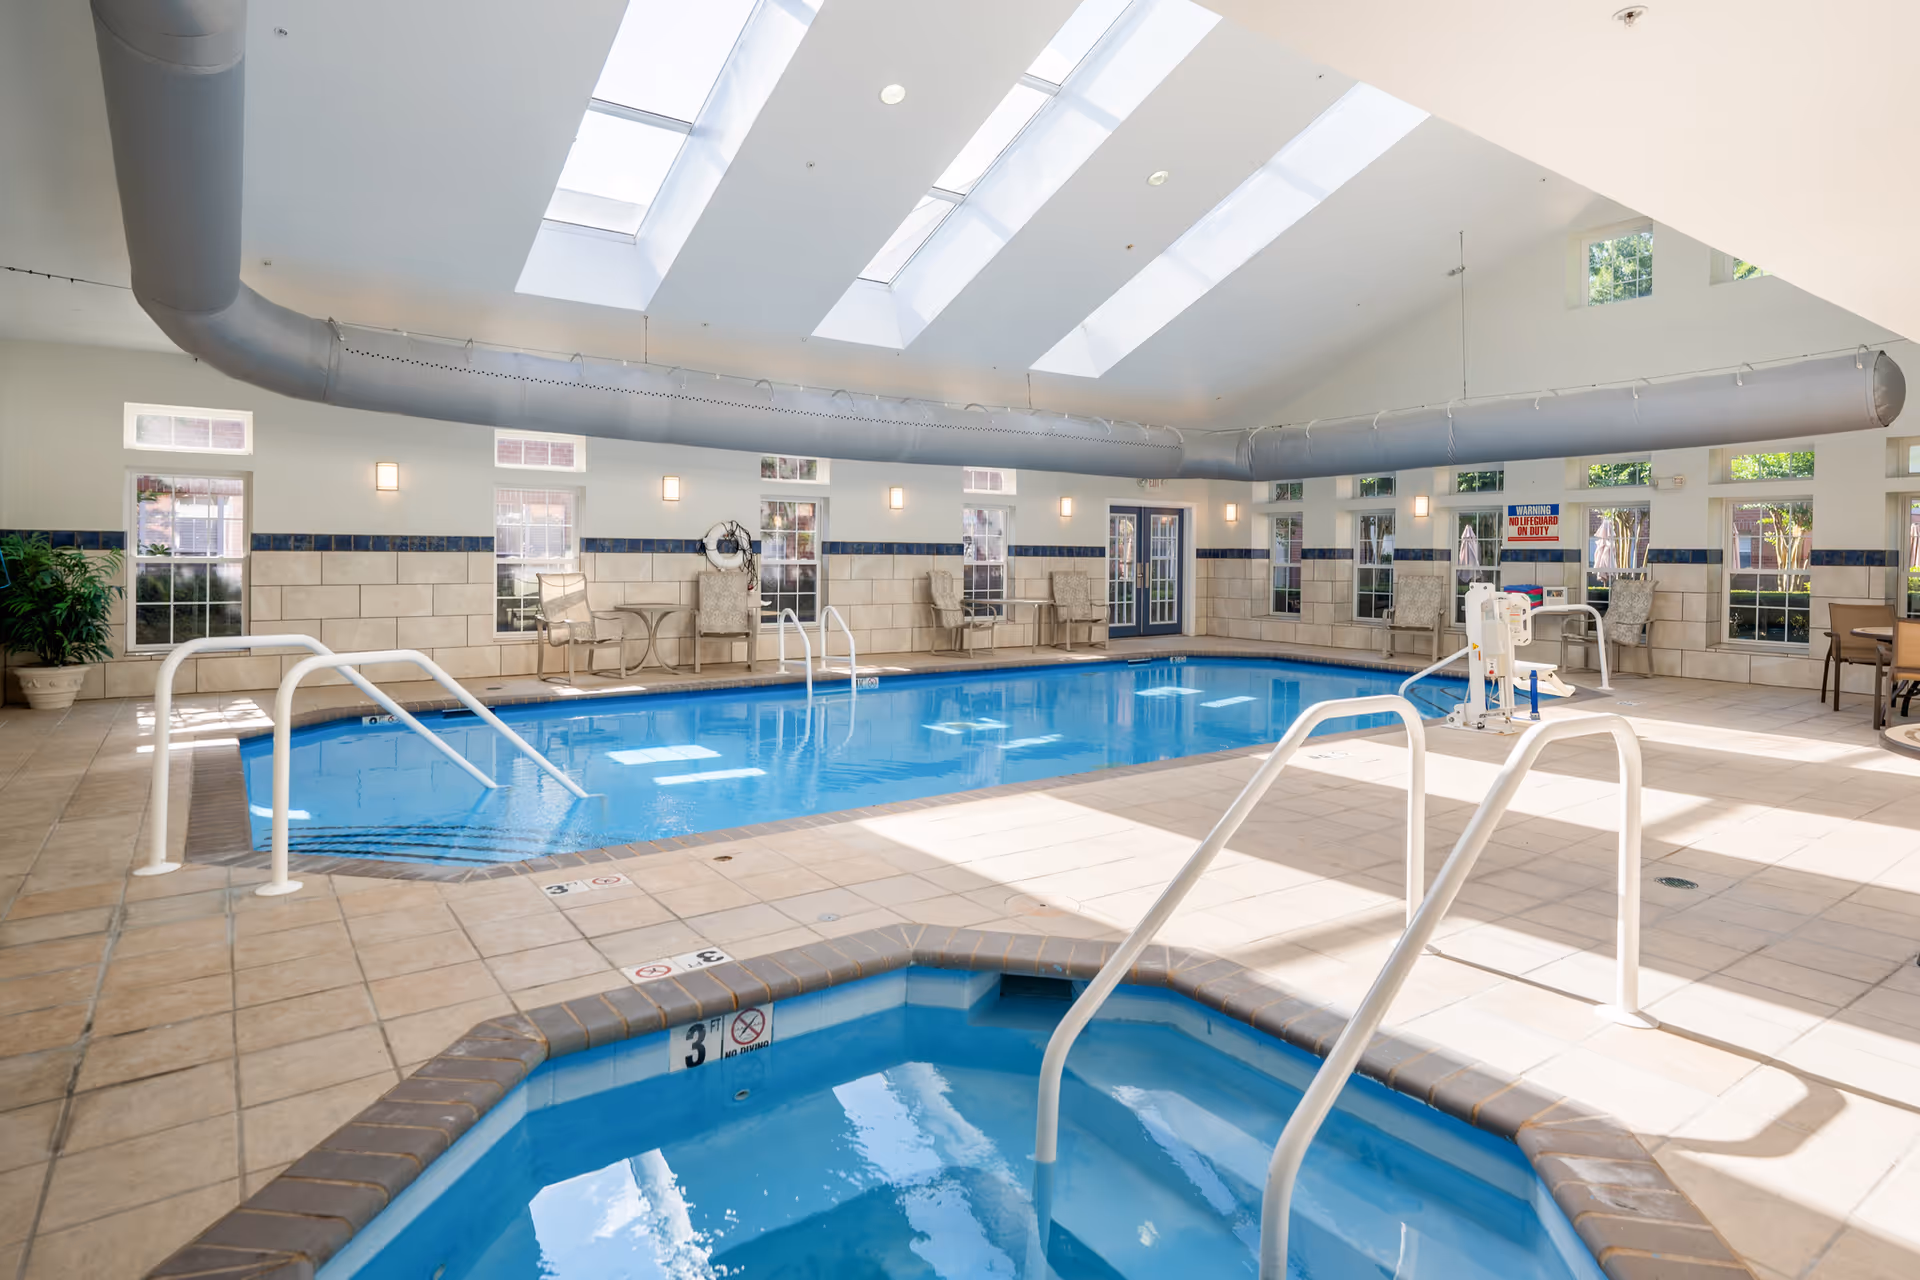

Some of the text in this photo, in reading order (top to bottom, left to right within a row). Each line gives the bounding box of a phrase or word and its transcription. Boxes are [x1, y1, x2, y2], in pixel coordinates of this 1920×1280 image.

[1516, 506, 1551, 515] WARNING
[1509, 516, 1558, 526] NO LIFEGUARD
[1517, 526, 1549, 536] ON DUTY
[545, 885, 568, 894] 3
[696, 951, 724, 962] 3
[685, 1018, 721, 1068] 3 FT
[725, 1049, 738, 1059] NO
